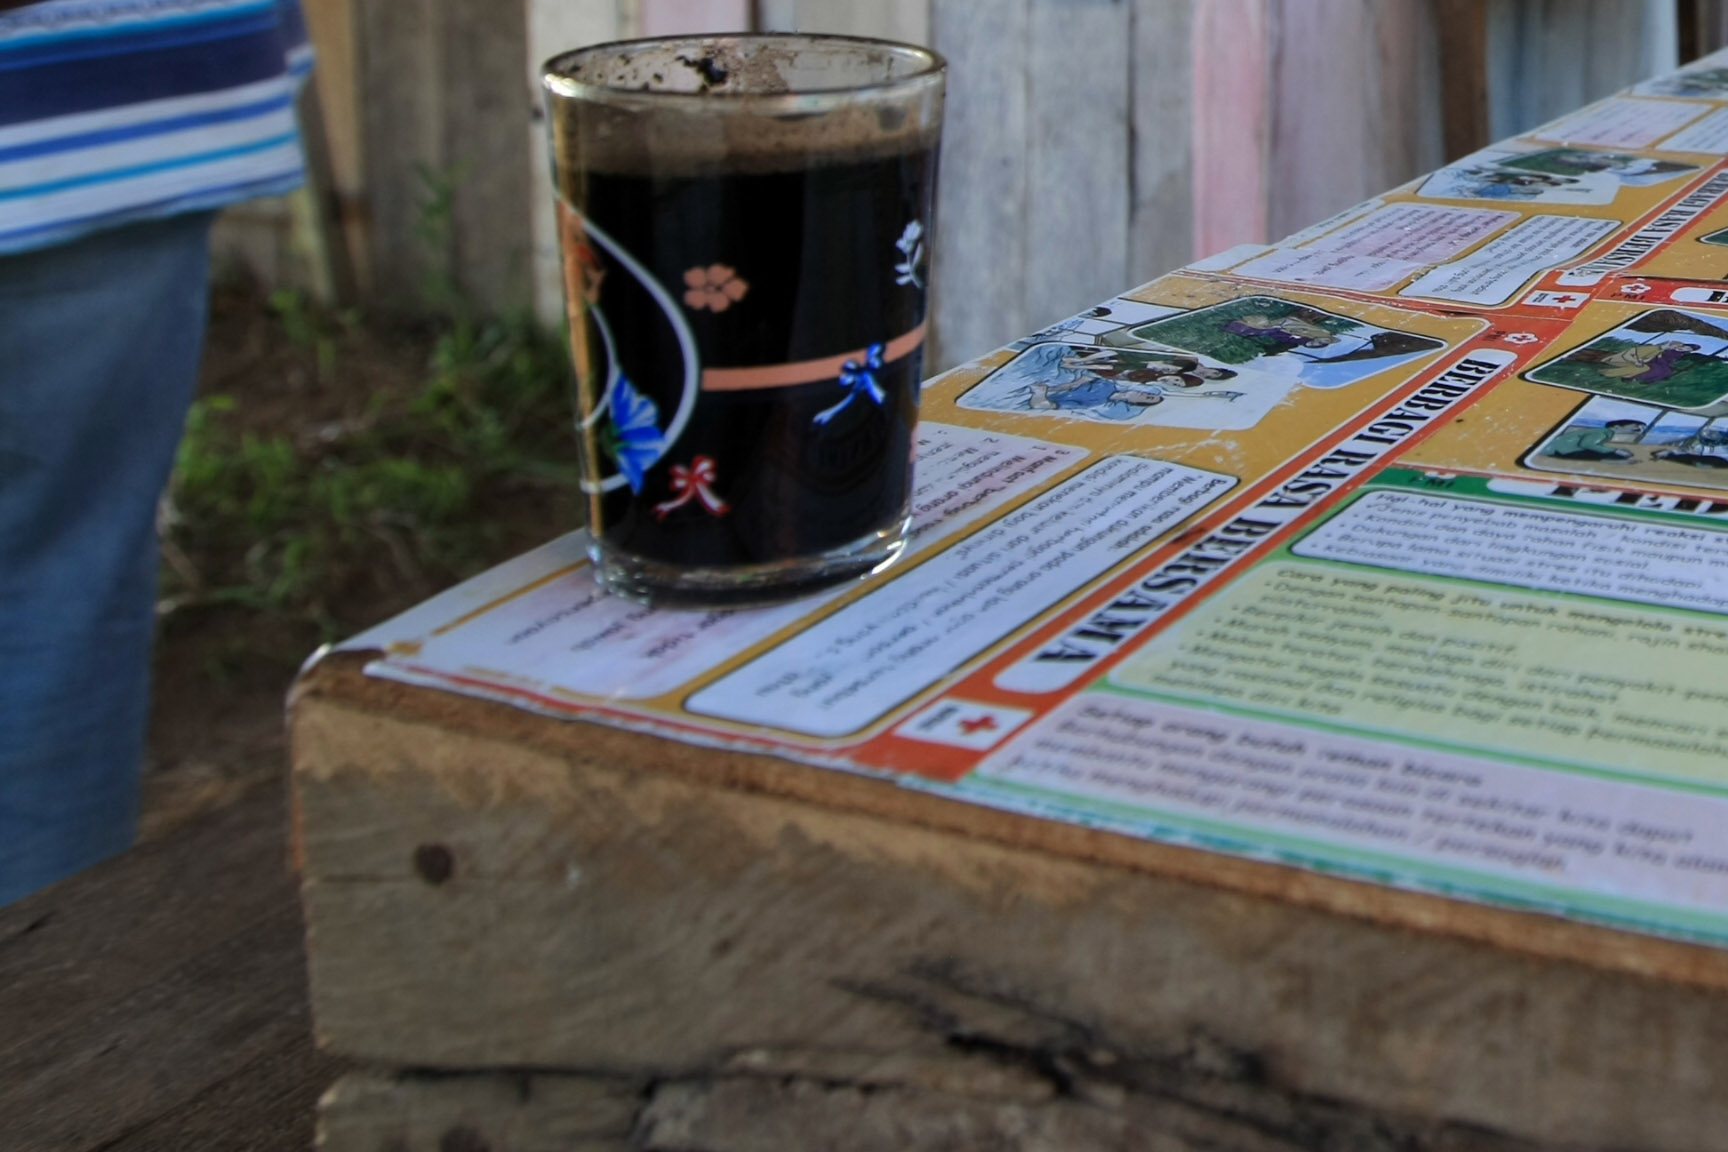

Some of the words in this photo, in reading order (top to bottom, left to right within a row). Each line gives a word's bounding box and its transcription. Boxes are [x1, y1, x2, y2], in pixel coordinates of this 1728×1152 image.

[1354, 358, 1501, 445] BERBAGI
[1260, 448, 1380, 508] RASA
[1031, 517, 1284, 663] BERSAMA
